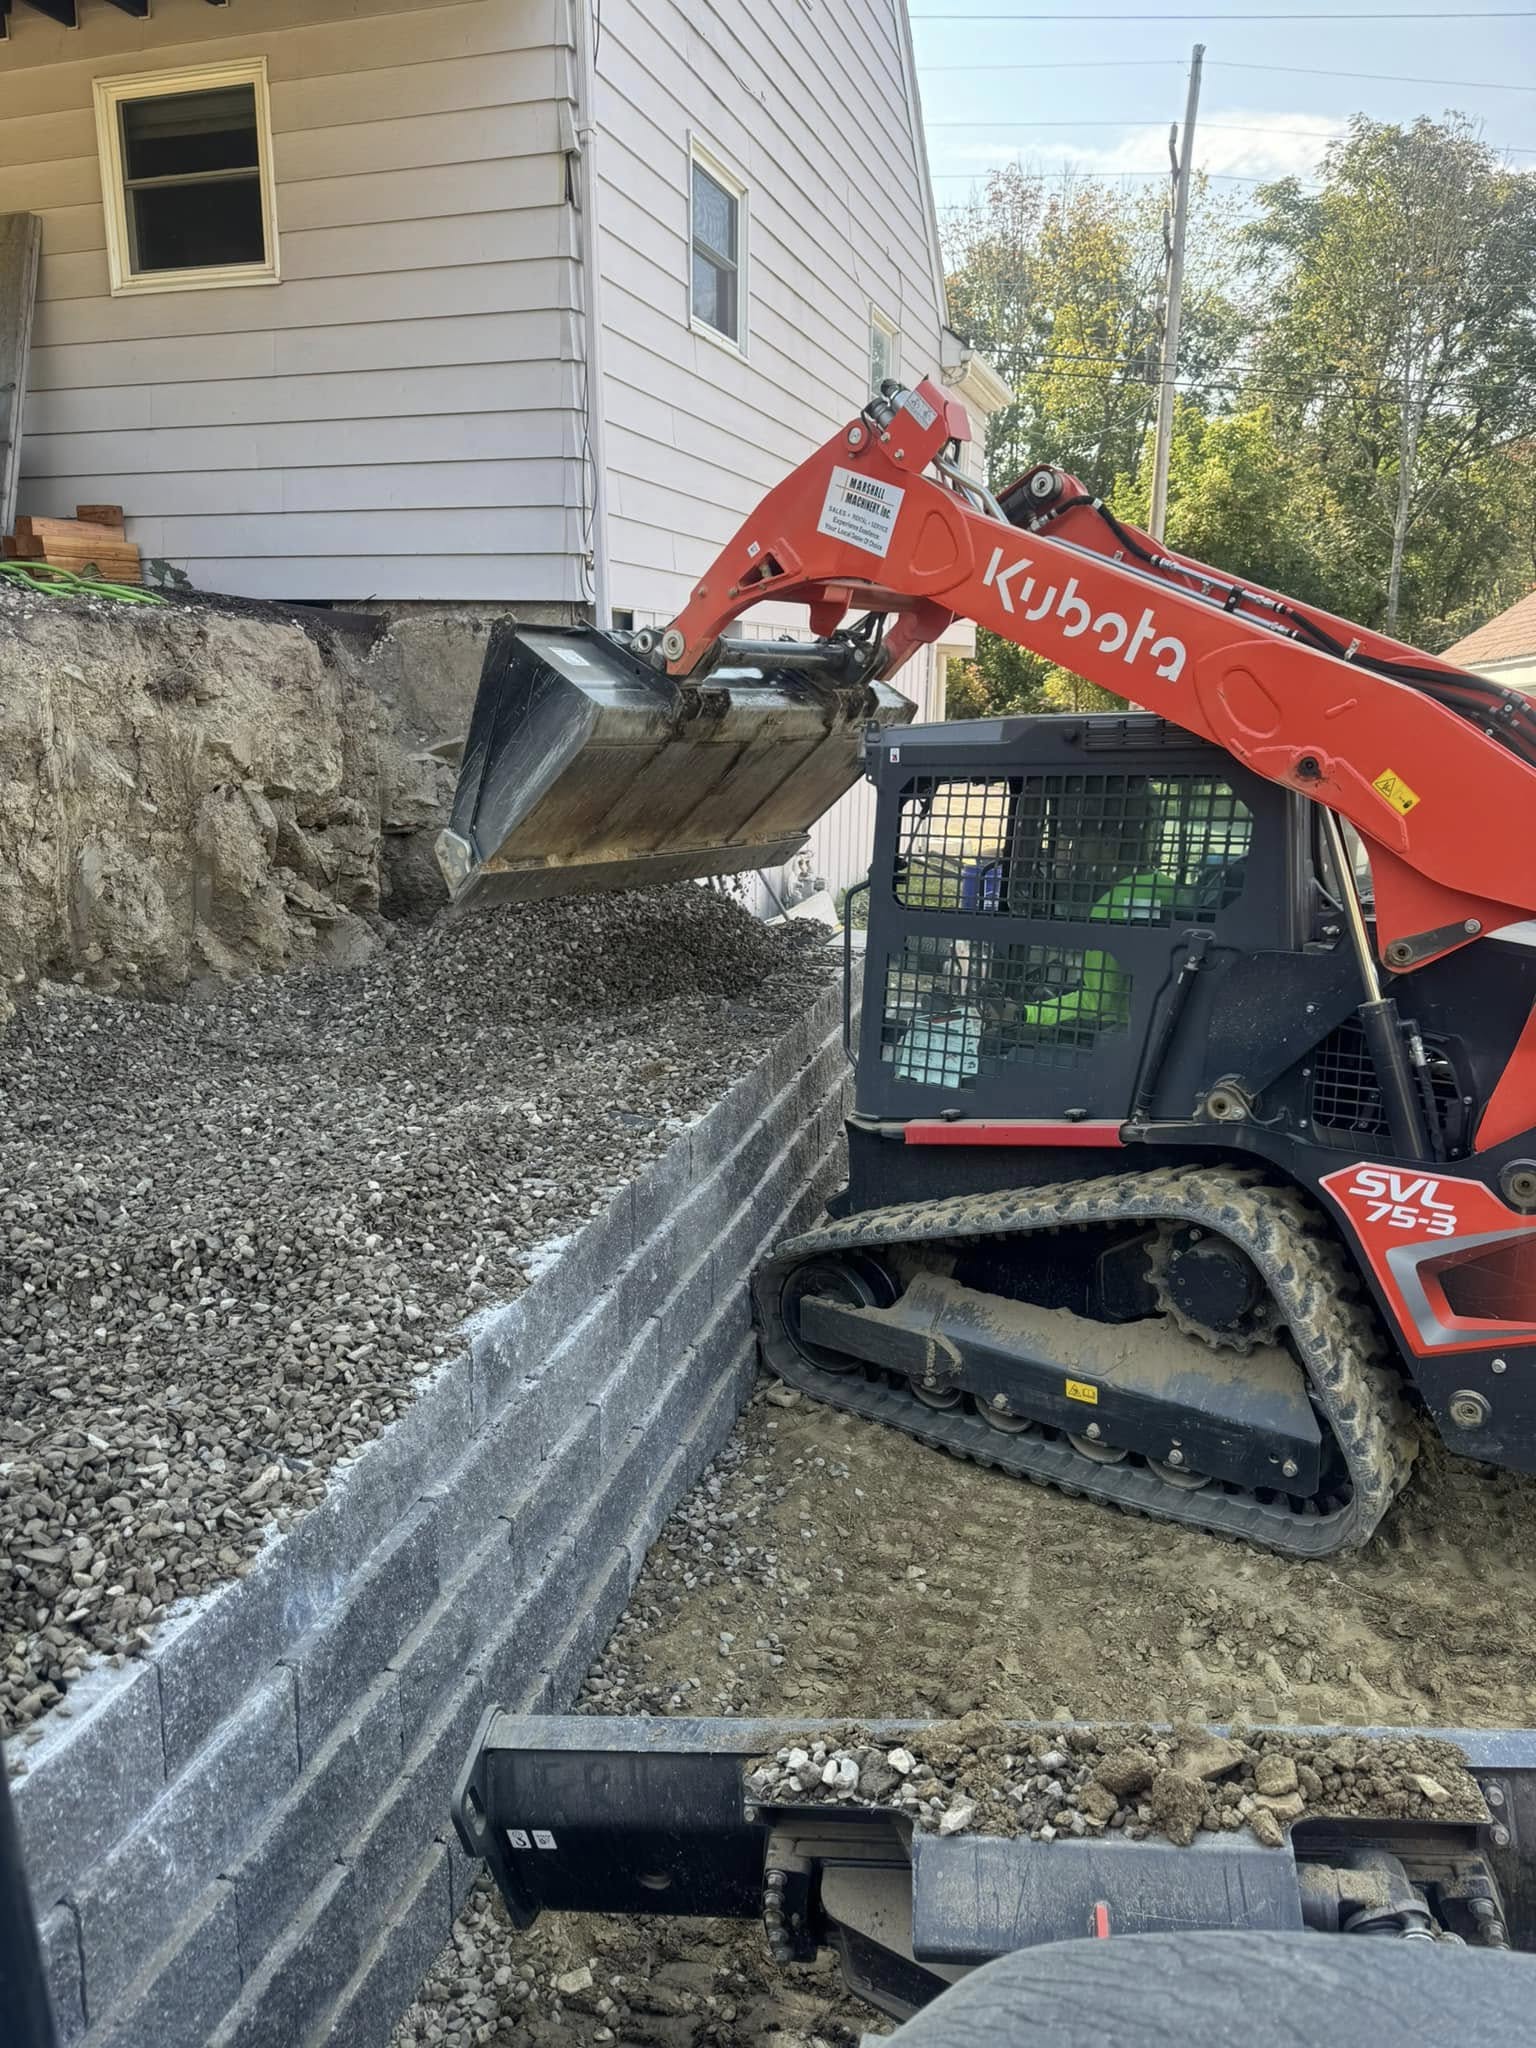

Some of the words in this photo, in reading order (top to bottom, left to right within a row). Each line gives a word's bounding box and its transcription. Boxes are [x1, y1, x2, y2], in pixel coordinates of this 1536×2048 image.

[849, 477, 885, 499] MARSHALL
[829, 505, 846, 517] SALES
[871, 521, 888, 533] SERVICE
[832, 516, 858, 530] Experience
[880, 505, 891, 519] Inc.
[825, 522, 837, 532] Your
[837, 526, 851, 538] Local
[982, 546, 1187, 682] Kubota
[1348, 1169, 1455, 1211] SVL
[1365, 1200, 1457, 1236] 75-3
